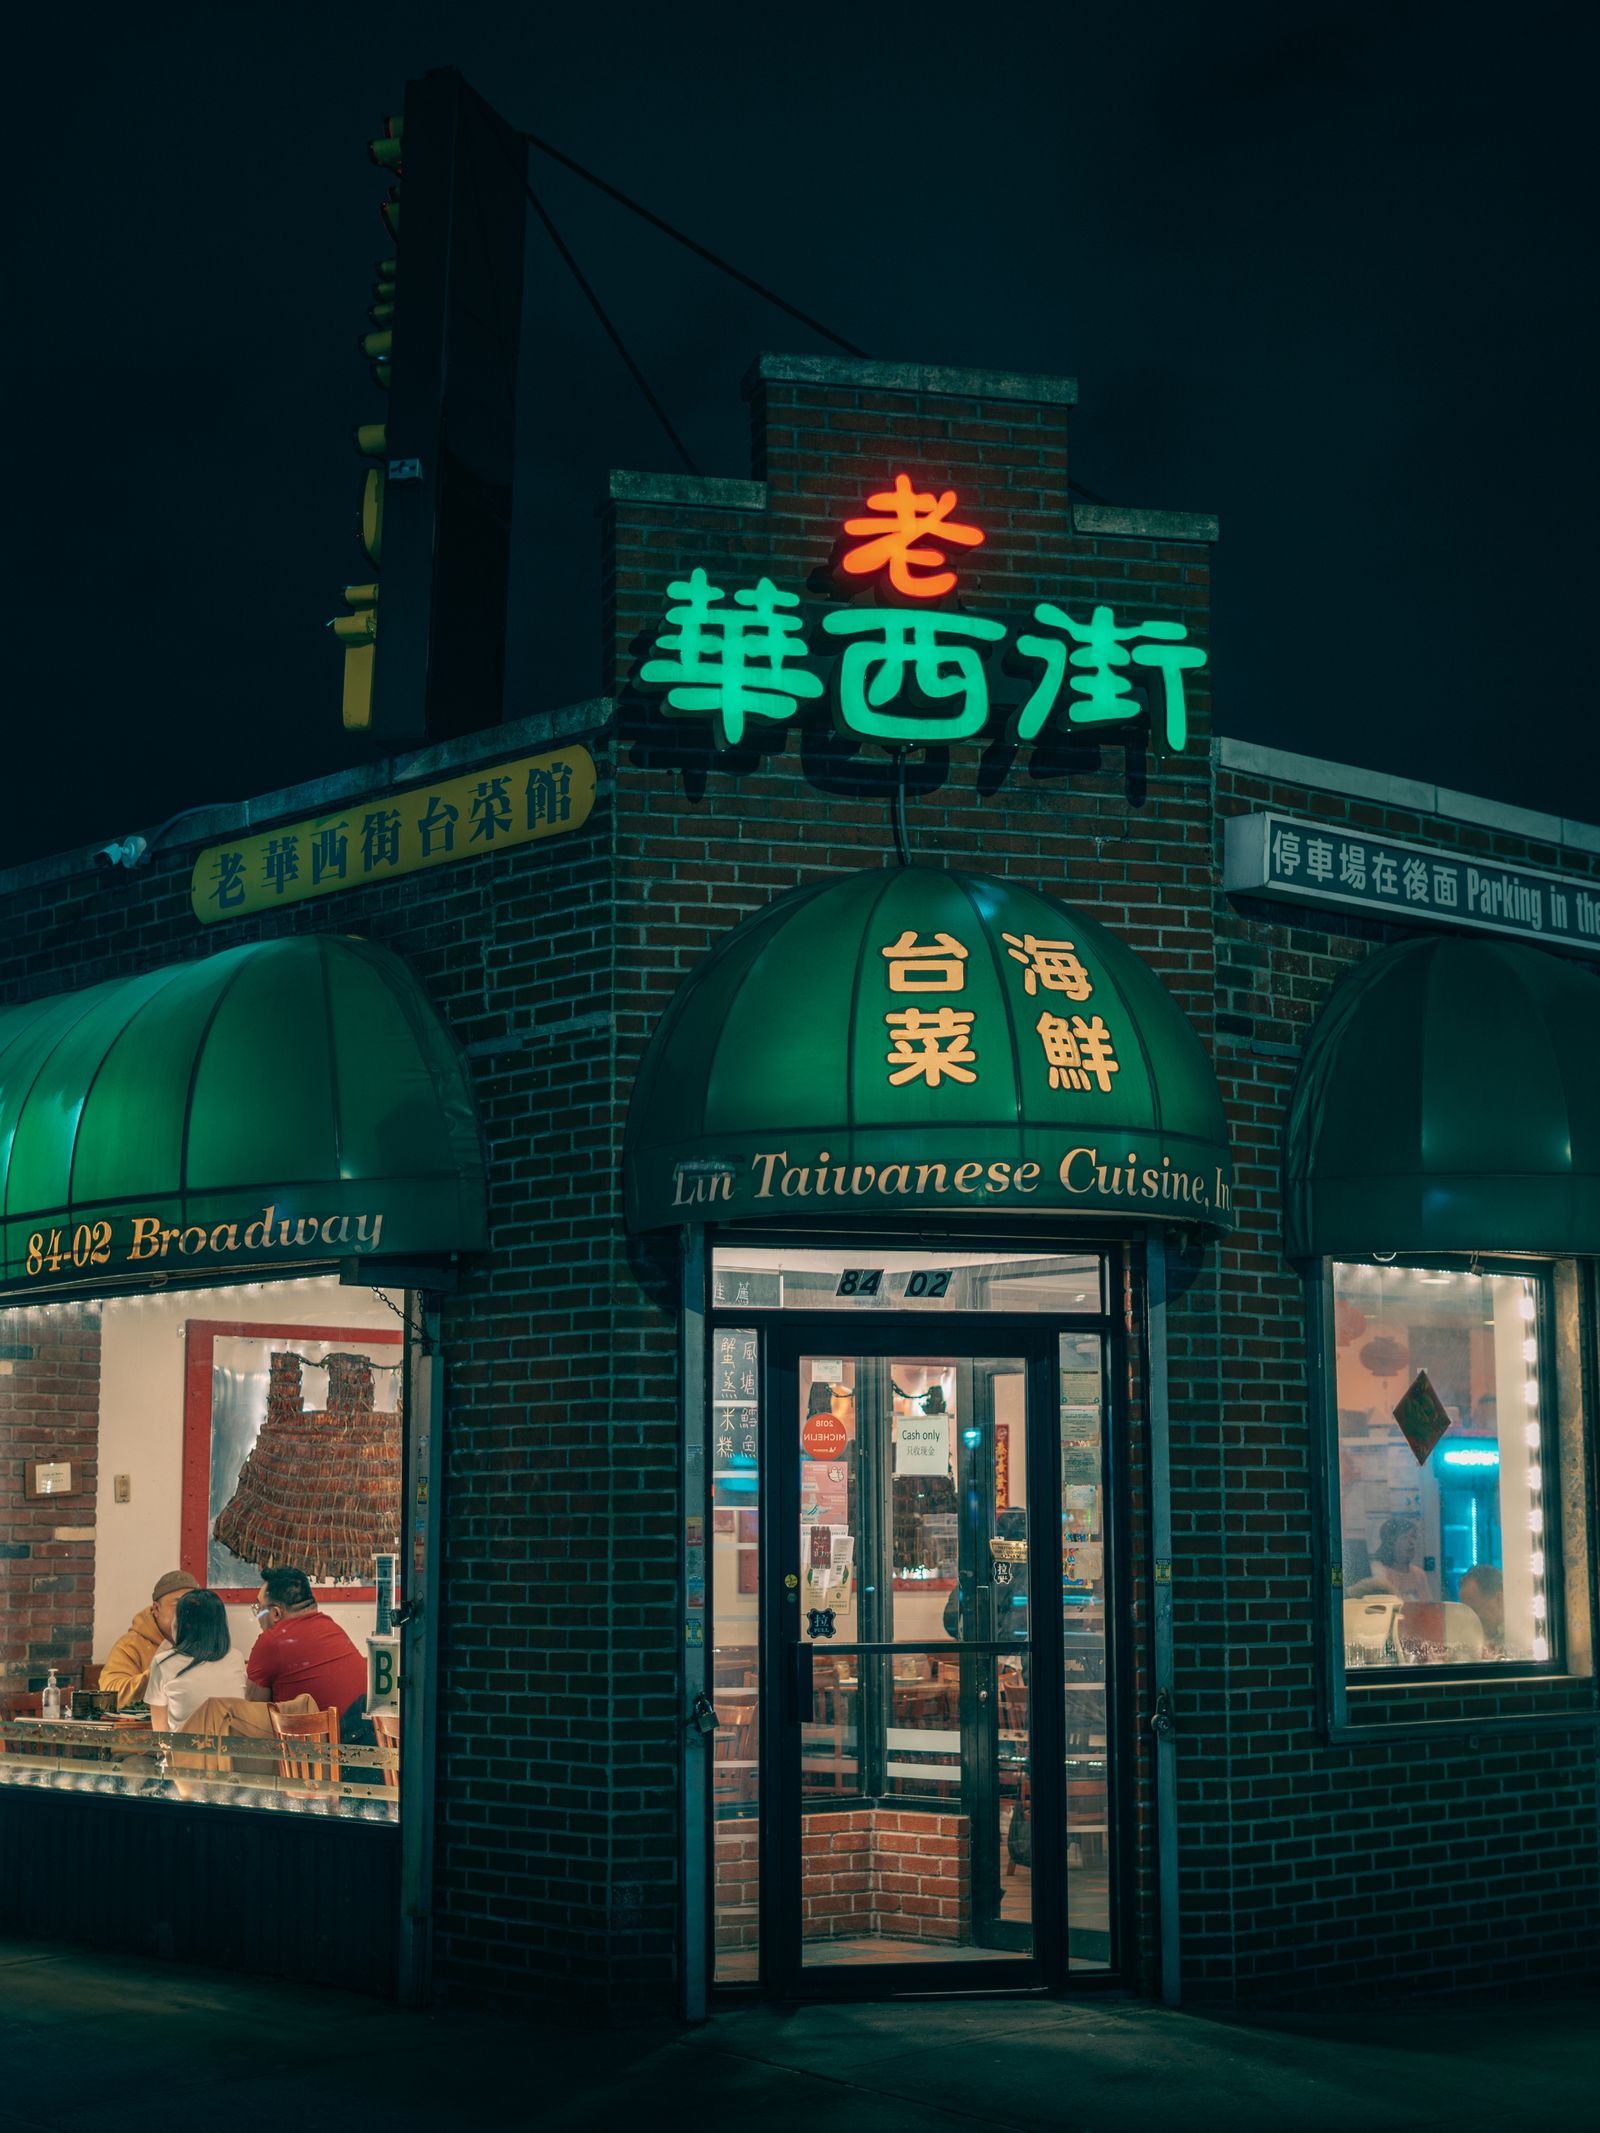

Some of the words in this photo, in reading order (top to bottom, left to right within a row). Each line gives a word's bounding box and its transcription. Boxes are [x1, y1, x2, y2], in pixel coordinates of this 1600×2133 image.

[842, 473, 985, 598] 老
[640, 567, 1207, 752] 華西街
[208, 761, 574, 910] 老華西街台菜館
[1272, 829, 1459, 908] 停車場在後面
[1466, 867, 1543, 931] Parking
[1550, 884, 1568, 930] in
[882, 930, 977, 1087] 台菜
[1002, 932, 1120, 1093] 海鮮
[751, 1149, 1040, 1200] Taiwanese
[1058, 1147, 1210, 1214] Cuisine,
[26, 1220, 113, 1277] 84-02
[126, 1203, 385, 1261] Broadway
[840, 1270, 881, 1296] 84
[908, 1272, 948, 1297] 02
[901, 1429, 920, 1440] Cash
[922, 1429, 941, 1443] only
[813, 1613, 830, 1628] 拉
[375, 1650, 393, 1695] B
